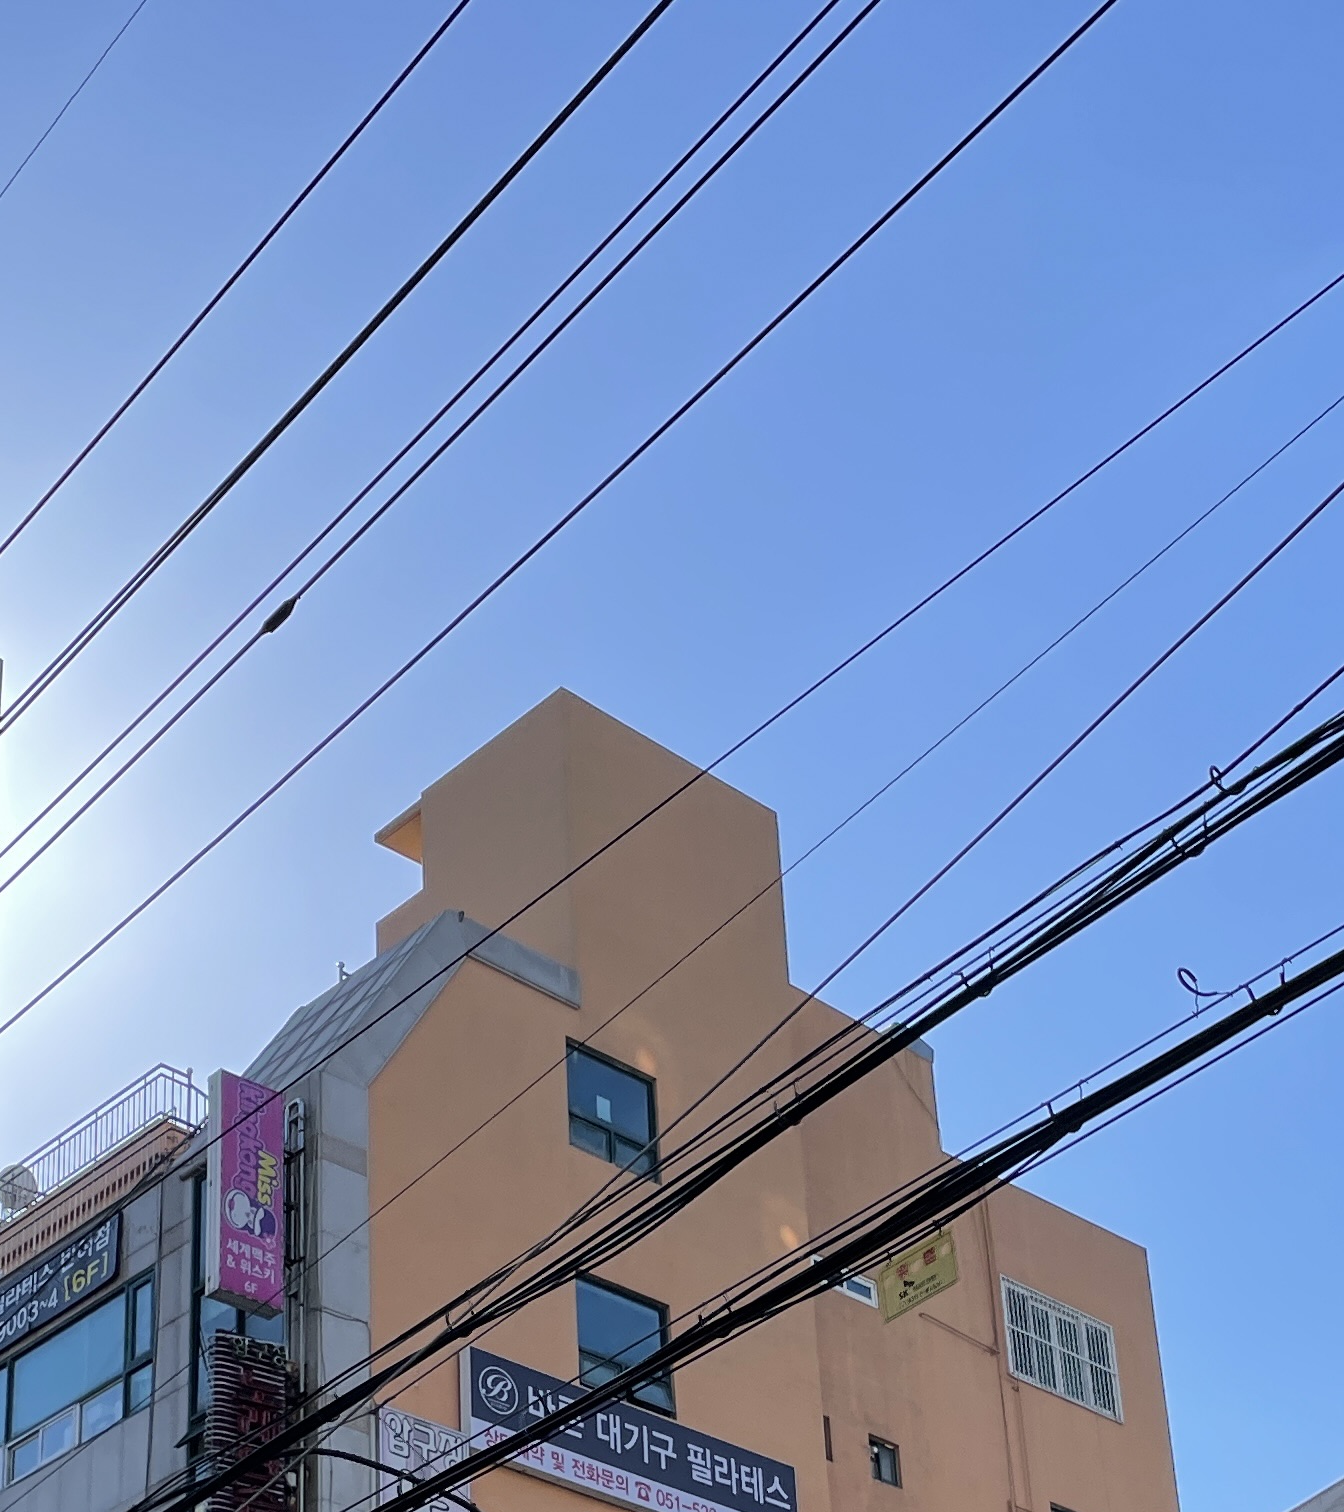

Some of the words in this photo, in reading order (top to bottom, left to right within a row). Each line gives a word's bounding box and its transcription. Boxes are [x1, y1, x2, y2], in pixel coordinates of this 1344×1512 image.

[227, 1238, 276, 1267] 세계맥주
[244, 1280, 259, 1295] 6F
[550, 1451, 567, 1474] 및
[571, 1457, 630, 1496] 전화문의
[596, 1411, 678, 1470] 대기구
[686, 1441, 792, 1511] 필라테스
